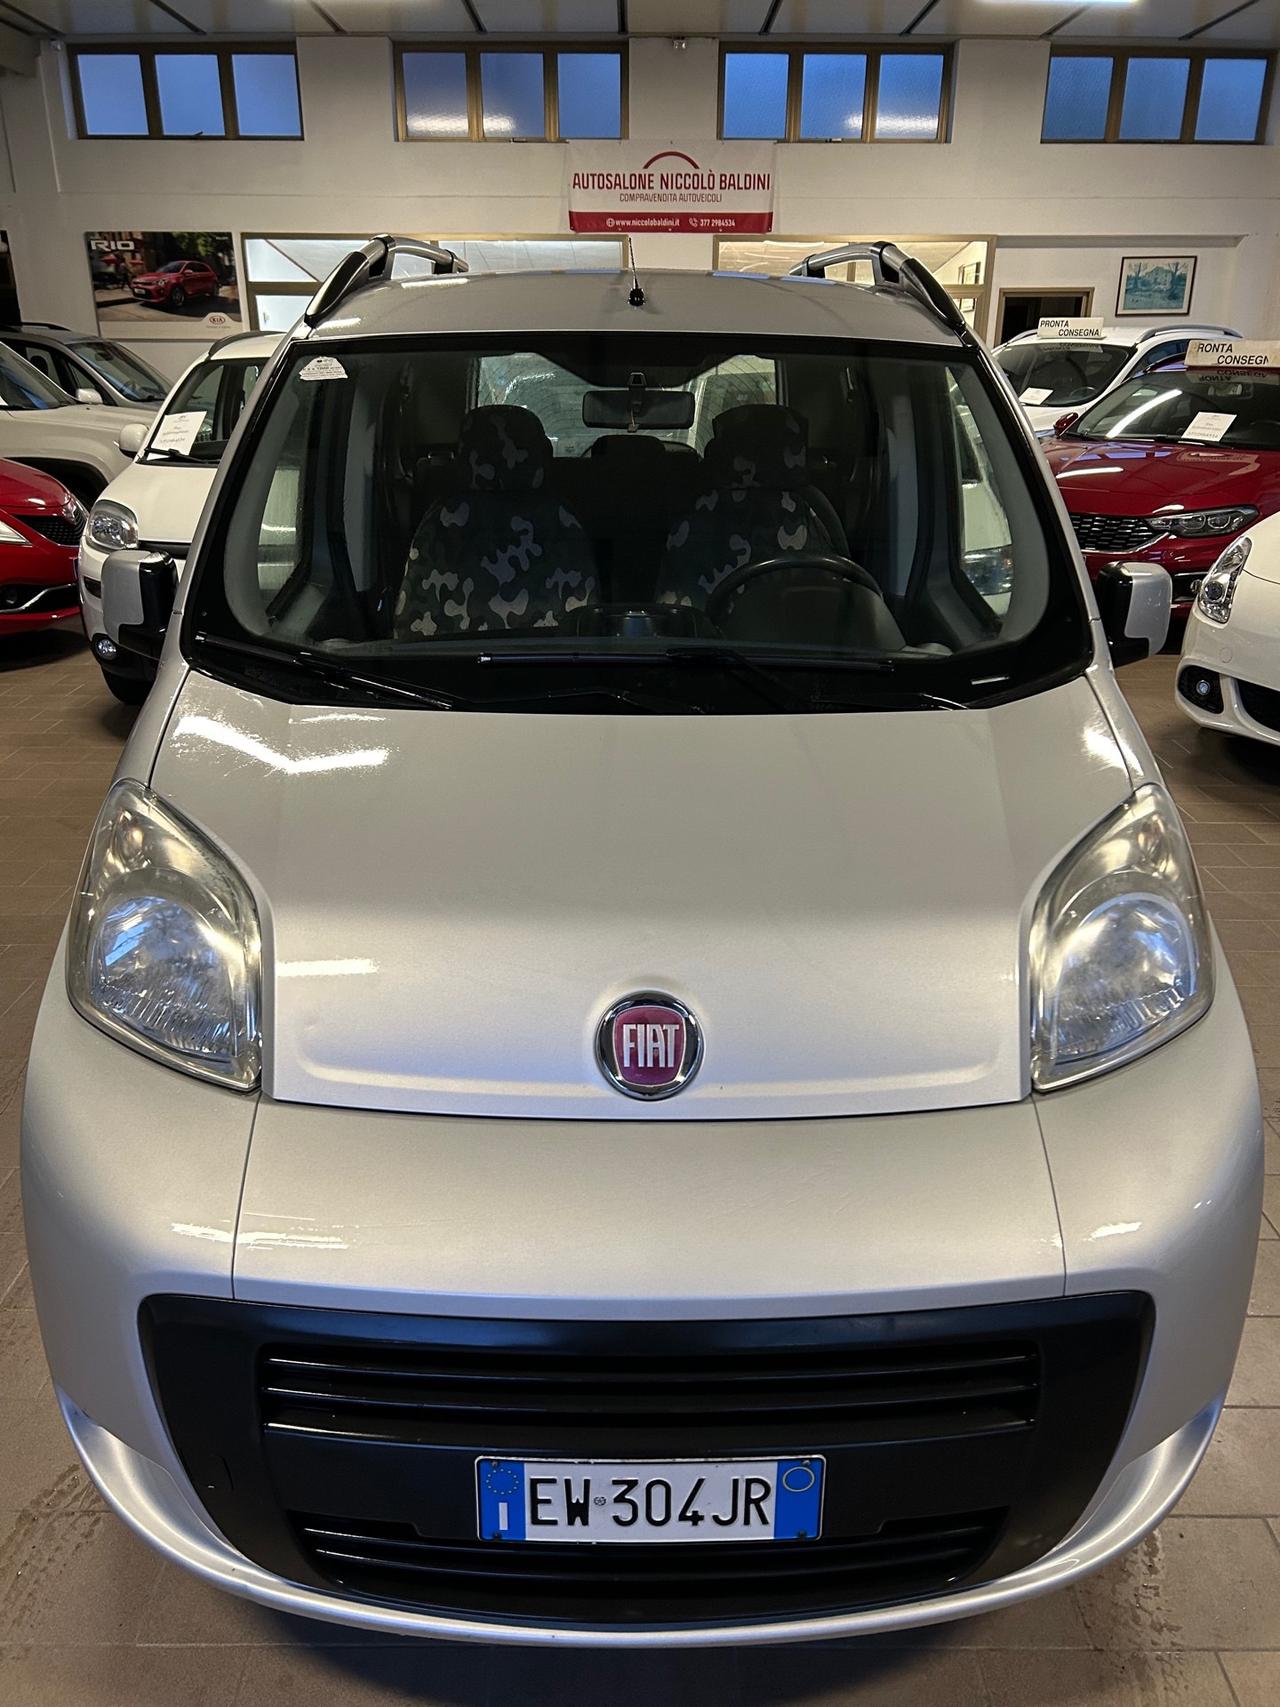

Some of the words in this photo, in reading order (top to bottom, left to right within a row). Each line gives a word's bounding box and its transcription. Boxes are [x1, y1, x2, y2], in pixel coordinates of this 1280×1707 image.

[572, 172, 654, 190] AUTOSALONE
[660, 169, 715, 190] NICCOLÒ
[719, 173, 770, 191] BALDINI
[620, 193, 677, 203] COMPRAVENDITA
[679, 193, 722, 203] AUTOVEICOLI
[615, 218, 680, 227] www.niccolobaldini.it
[700, 218, 710, 227] 377
[90, 240, 135, 252] RIO
[1040, 320, 1069, 328] PRONTA
[1058, 328, 1100, 337] CONSEGNA
[623, 1023, 680, 1068] FIAT
[529, 1477, 591, 1526] EW
